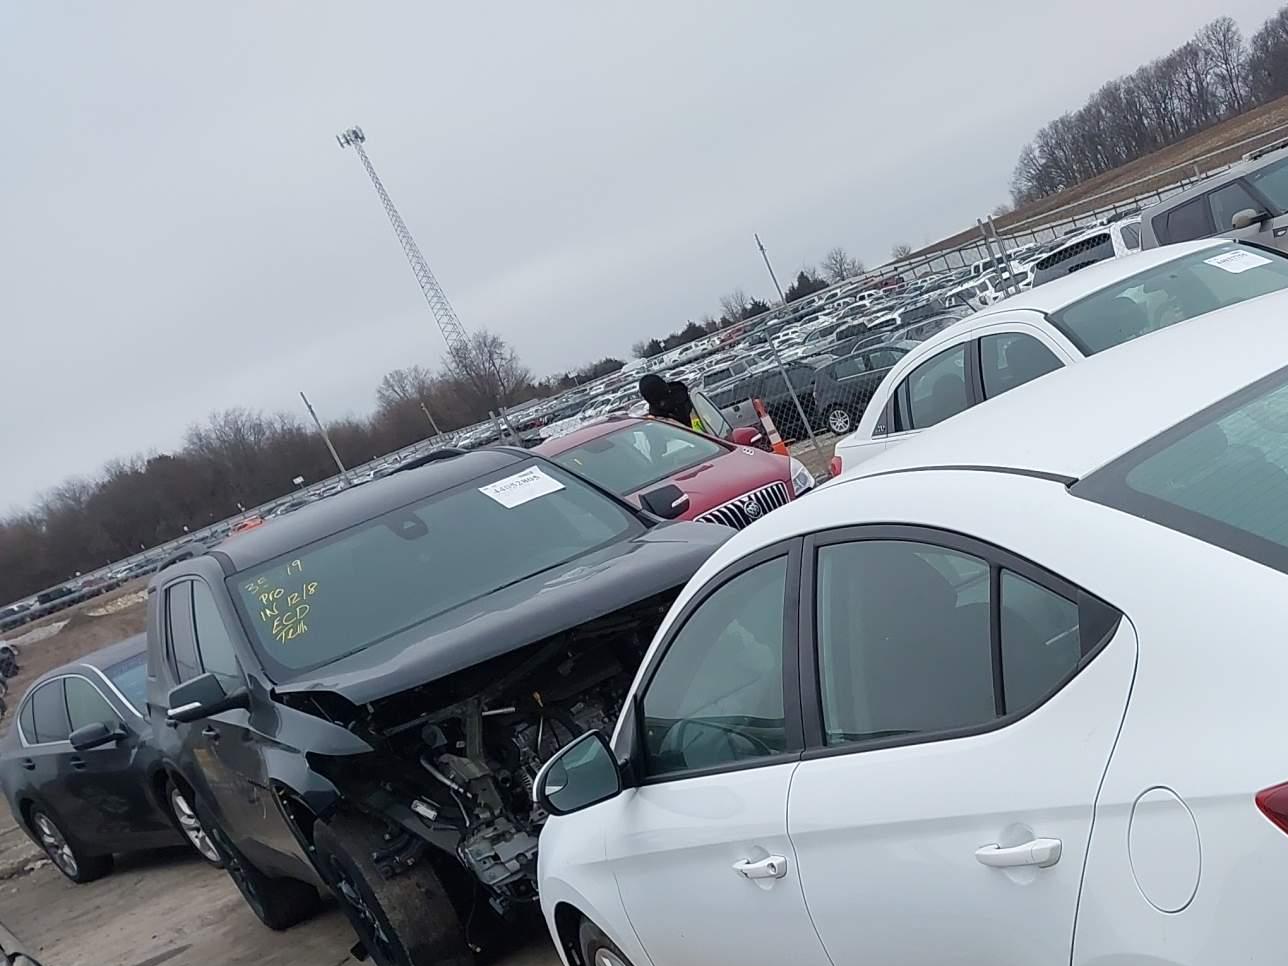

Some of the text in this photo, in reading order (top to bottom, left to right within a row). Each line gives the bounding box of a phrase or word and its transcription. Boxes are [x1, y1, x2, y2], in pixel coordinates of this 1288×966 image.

[287, 559, 303, 576] 19
[260, 582, 318, 621] IN 12/8
[272, 604, 310, 634] ECD
